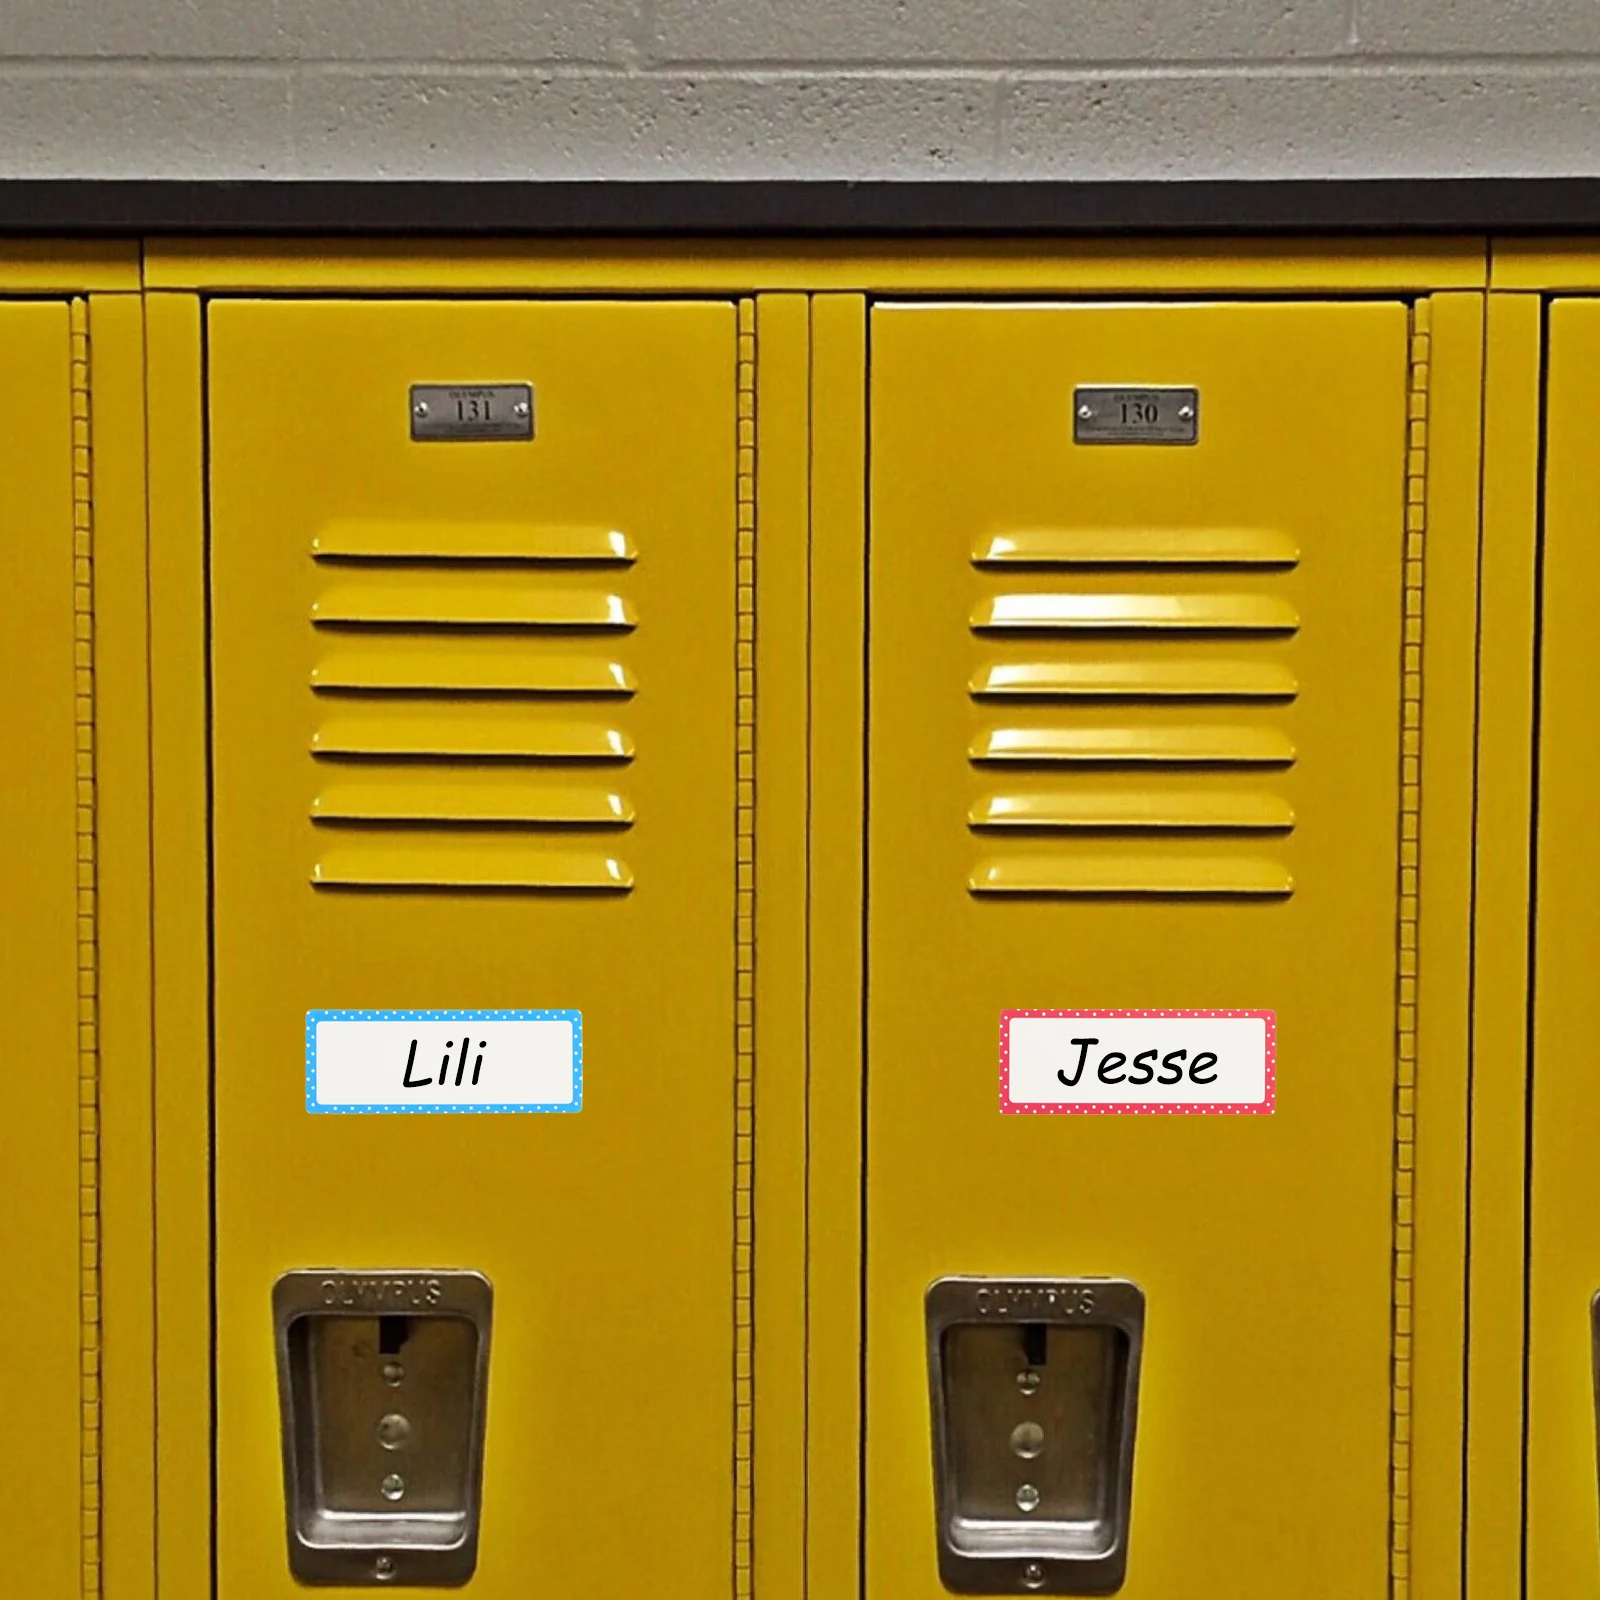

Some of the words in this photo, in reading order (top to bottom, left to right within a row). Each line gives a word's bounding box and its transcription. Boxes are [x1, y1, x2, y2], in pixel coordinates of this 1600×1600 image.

[456, 400, 491, 421] 131
[1121, 403, 1158, 424] 130
[403, 1037, 487, 1088] Lili
[1057, 1038, 1218, 1087] Jesse
